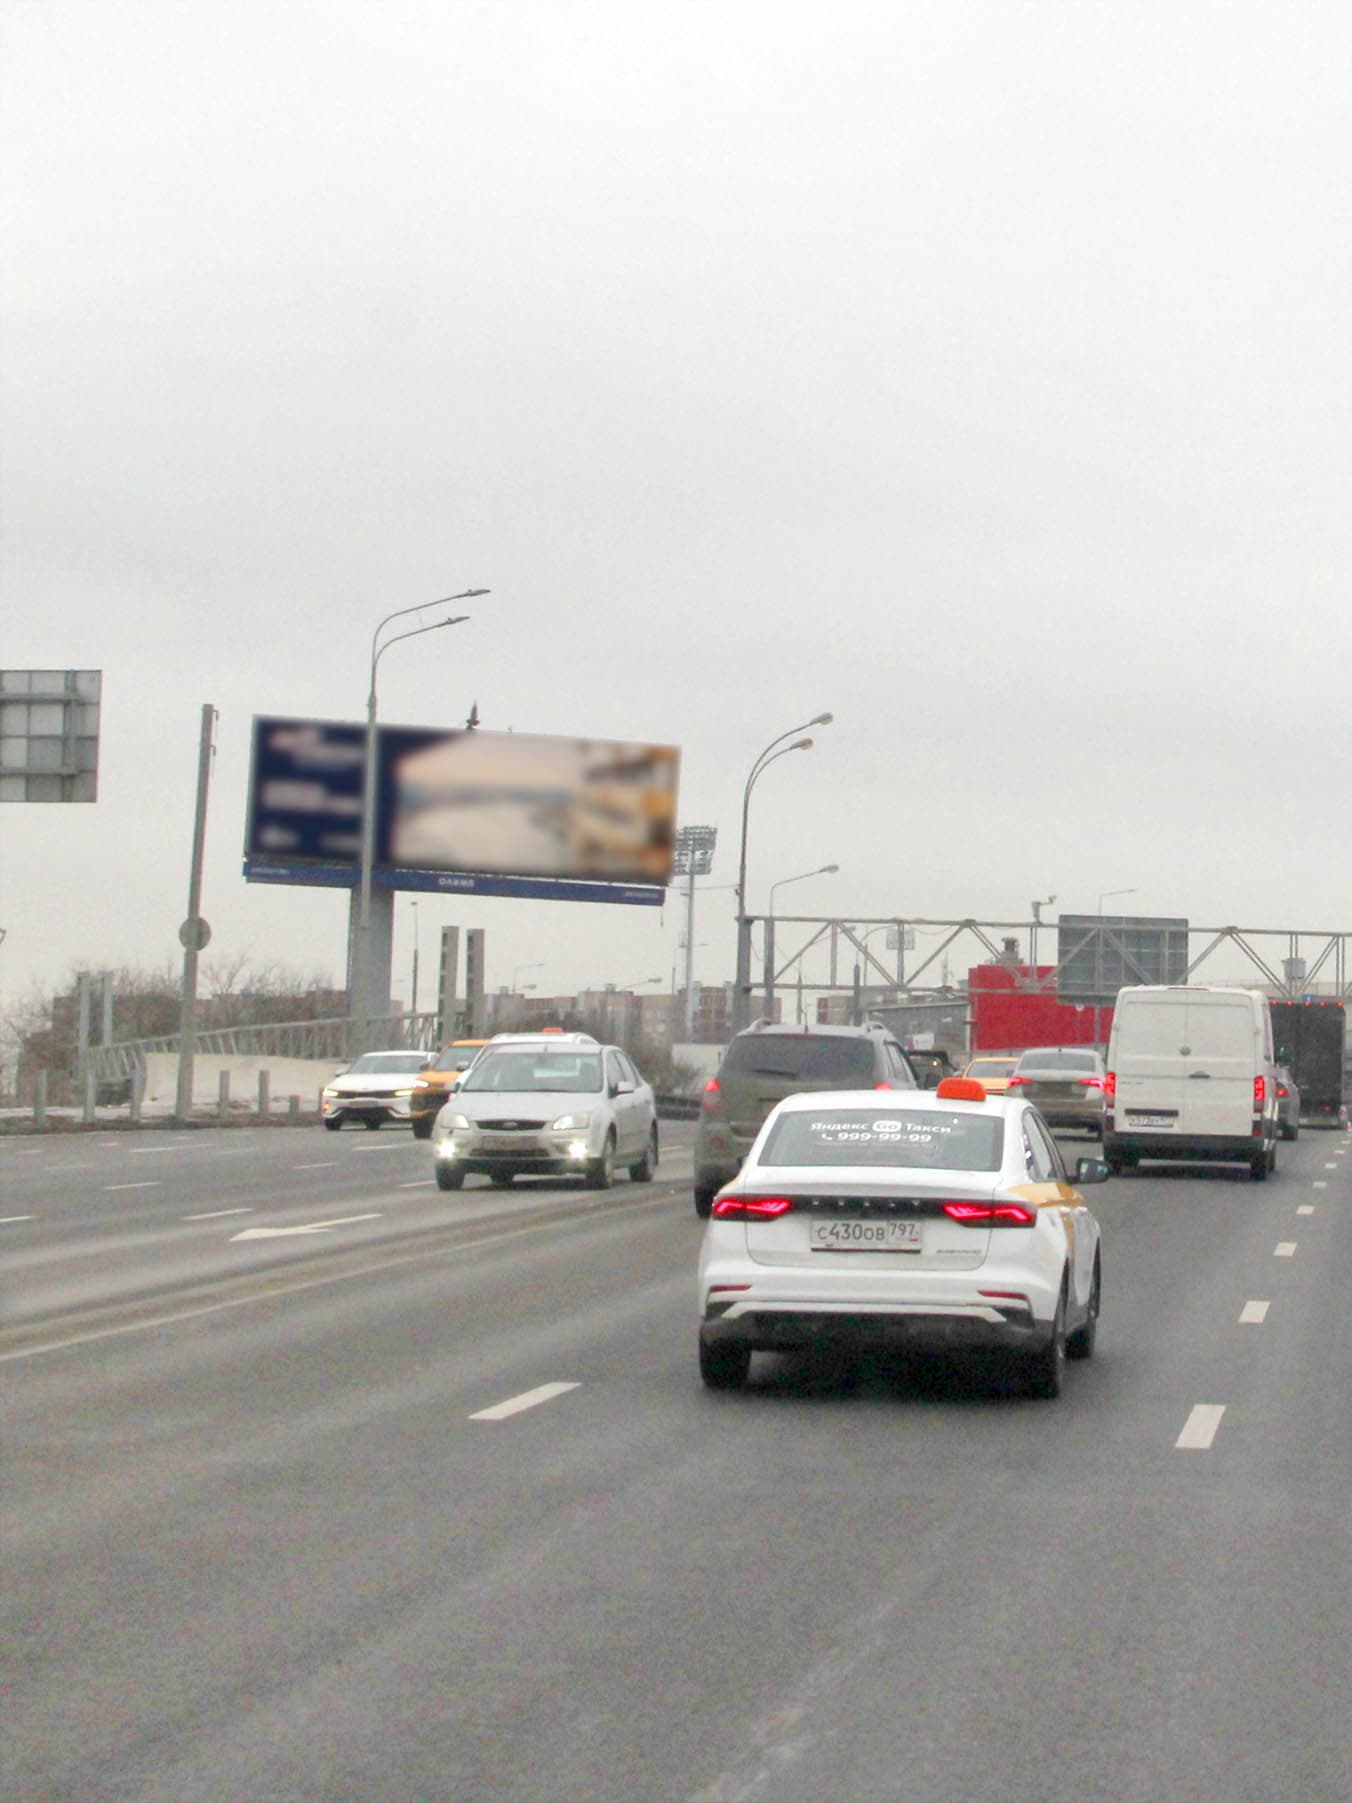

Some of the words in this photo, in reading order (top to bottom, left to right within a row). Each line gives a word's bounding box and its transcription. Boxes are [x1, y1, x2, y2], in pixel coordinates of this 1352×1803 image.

[810, 1122, 869, 1131] Яндекс
[906, 1123, 951, 1133] Такси
[837, 1132, 932, 1143] 999-99-99
[817, 1223, 886, 1241] С430ОВ
[890, 1223, 914, 1236] 797
